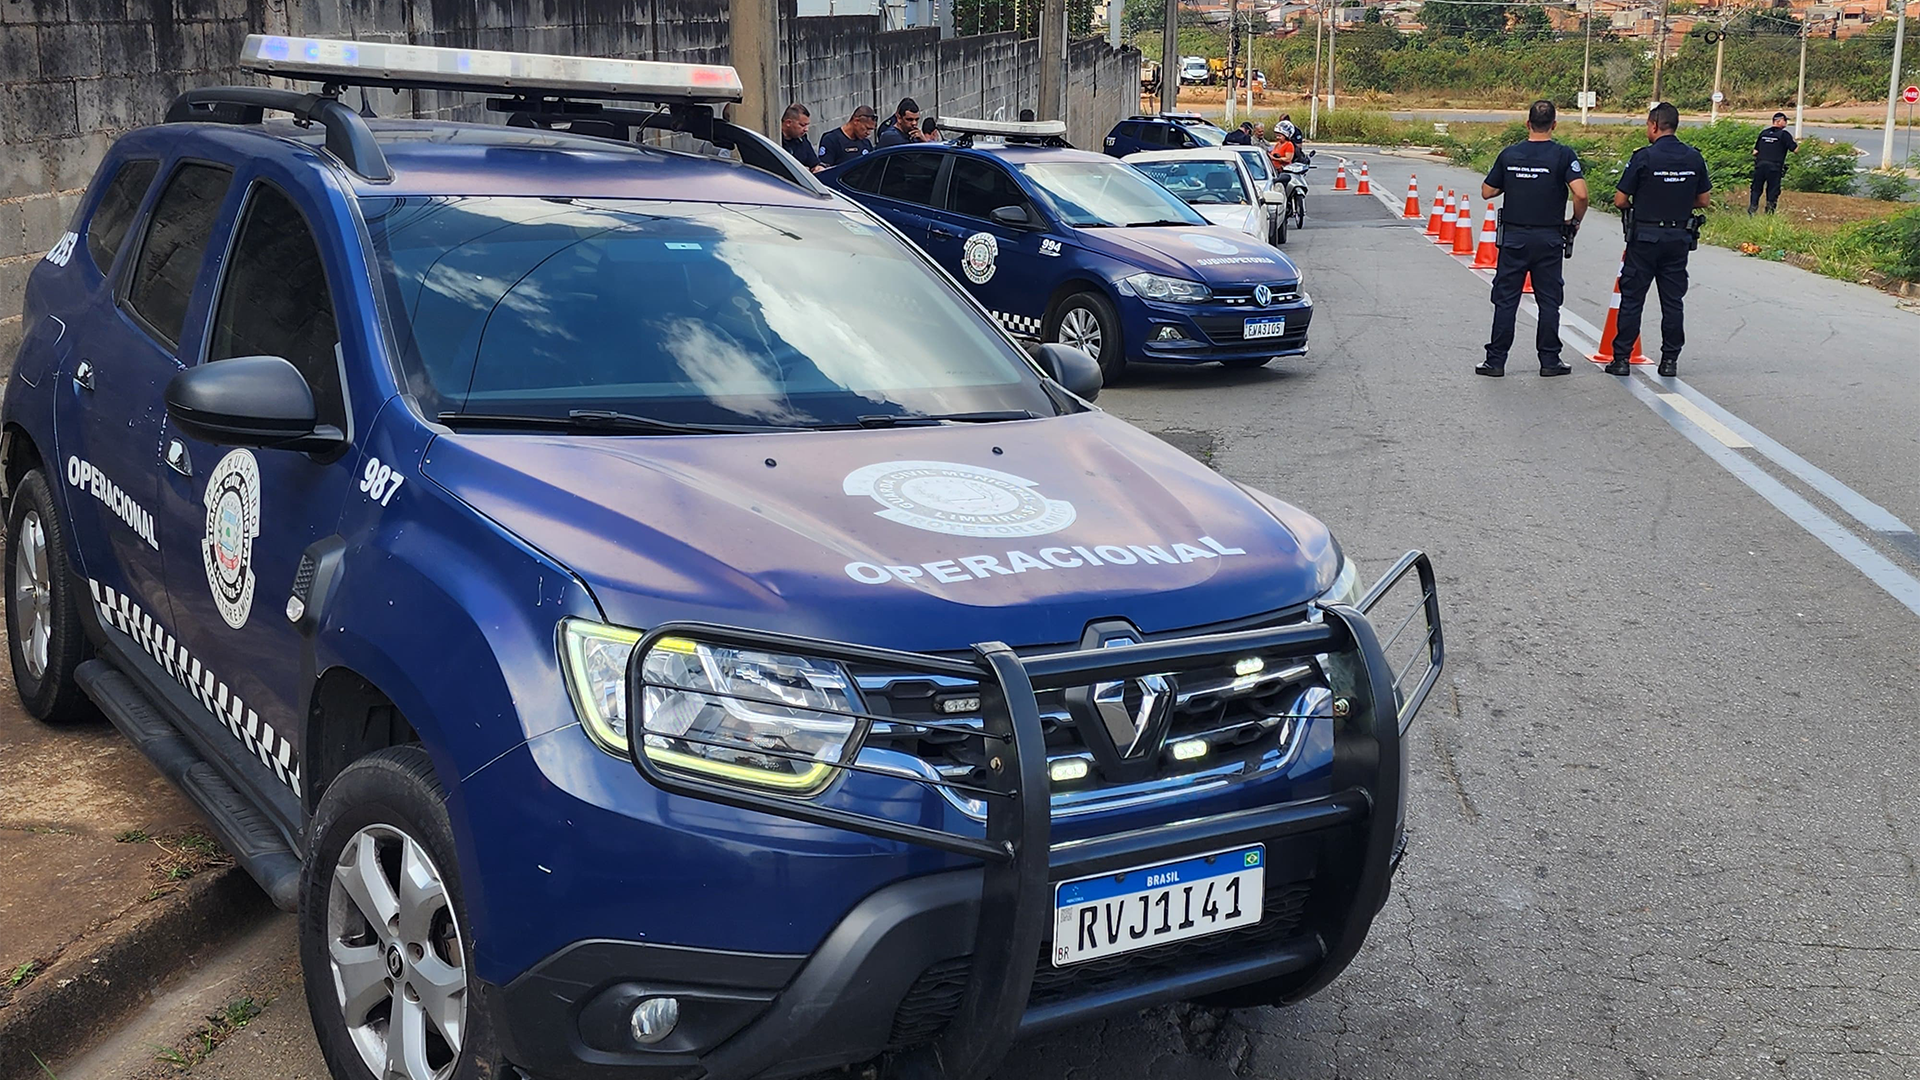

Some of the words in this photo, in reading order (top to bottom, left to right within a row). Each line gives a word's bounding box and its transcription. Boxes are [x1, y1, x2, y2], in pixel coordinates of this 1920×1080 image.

[1041, 238, 1062, 253] 994
[206, 454, 258, 528] PATRULHEIRO
[360, 457, 404, 507] 987
[879, 478, 914, 510] GUARDA
[893, 469, 938, 480] CIVIL
[941, 470, 1037, 503] MUNICIPAL
[67, 455, 159, 551] OPERACIONAL
[208, 485, 225, 545] GUARDA
[239, 482, 251, 568] MUNICIPAL
[843, 536, 1247, 585] OPERACIONAL
[1146, 871, 1180, 887] BRASIL
[1077, 876, 1243, 952] RVJ1I41
[1058, 946, 1070, 961] BR
